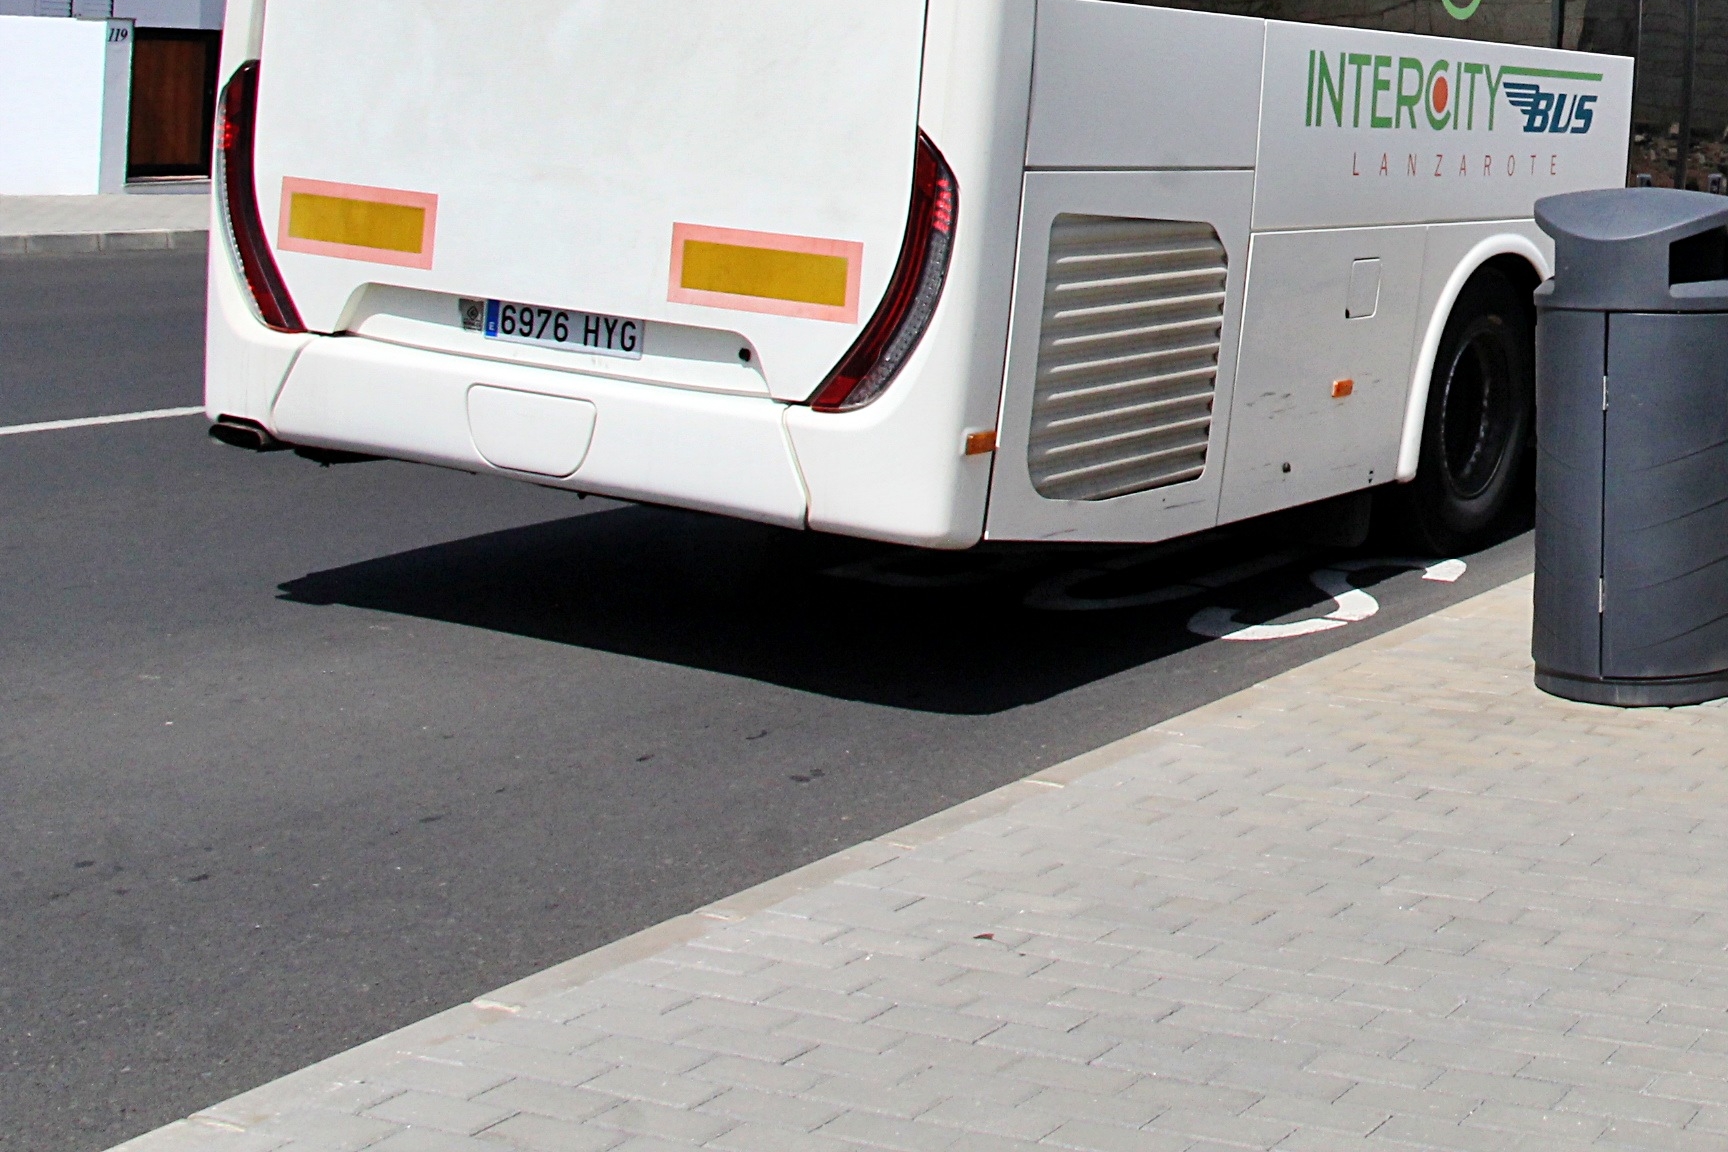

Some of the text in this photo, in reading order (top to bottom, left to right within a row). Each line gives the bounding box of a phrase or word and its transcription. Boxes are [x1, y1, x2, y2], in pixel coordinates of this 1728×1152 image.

[108, 28, 128, 42] 119
[1304, 49, 1599, 135] INTERCITY BUS
[1352, 152, 1557, 177] LANZAROTE
[501, 304, 636, 352] 6976 HYG
